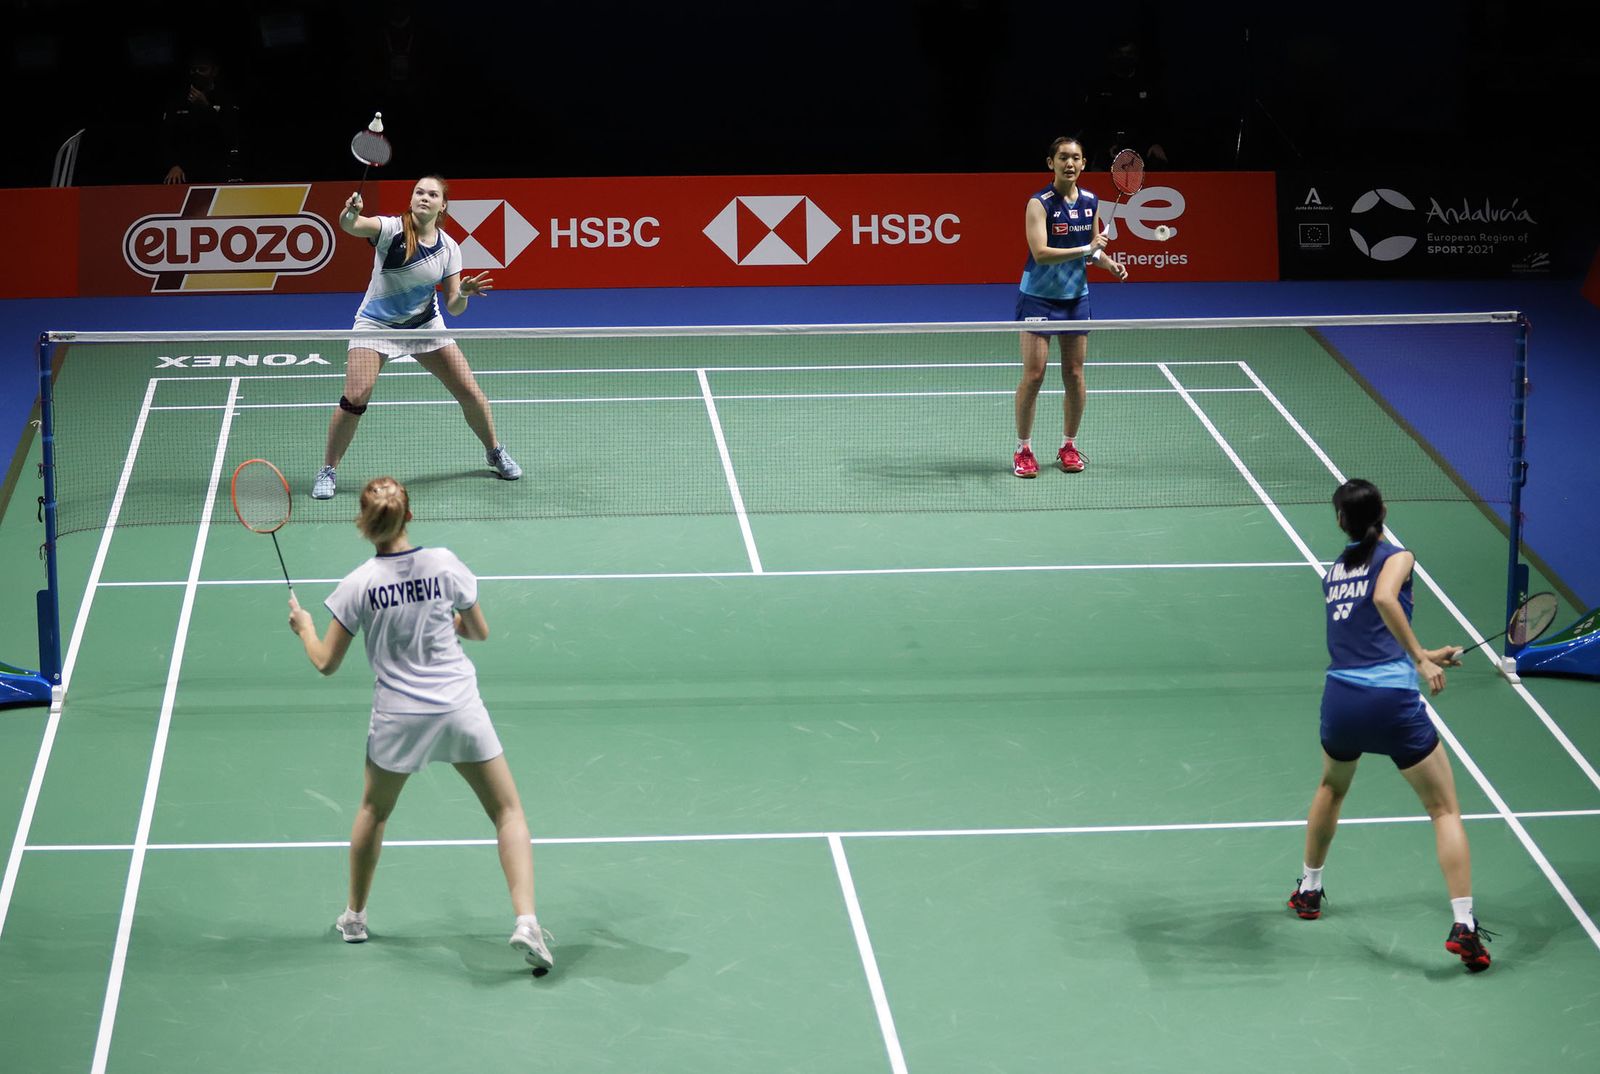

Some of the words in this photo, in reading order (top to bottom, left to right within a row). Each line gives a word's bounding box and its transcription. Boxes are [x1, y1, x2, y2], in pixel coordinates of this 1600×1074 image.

[1425, 196, 1538, 225] Andalucía
[550, 217, 660, 249] HSBC
[852, 213, 961, 246] HSBC
[1427, 233, 1477, 245] European
[1479, 232, 1515, 244] Region
[1517, 232, 1529, 243] of
[1427, 245, 1465, 254] SPORT
[1467, 245, 1494, 254] 2021
[154, 353, 331, 369] YONEX
[368, 577, 441, 611] KOZYREVA
[1326, 580, 1369, 604] JAPAN
